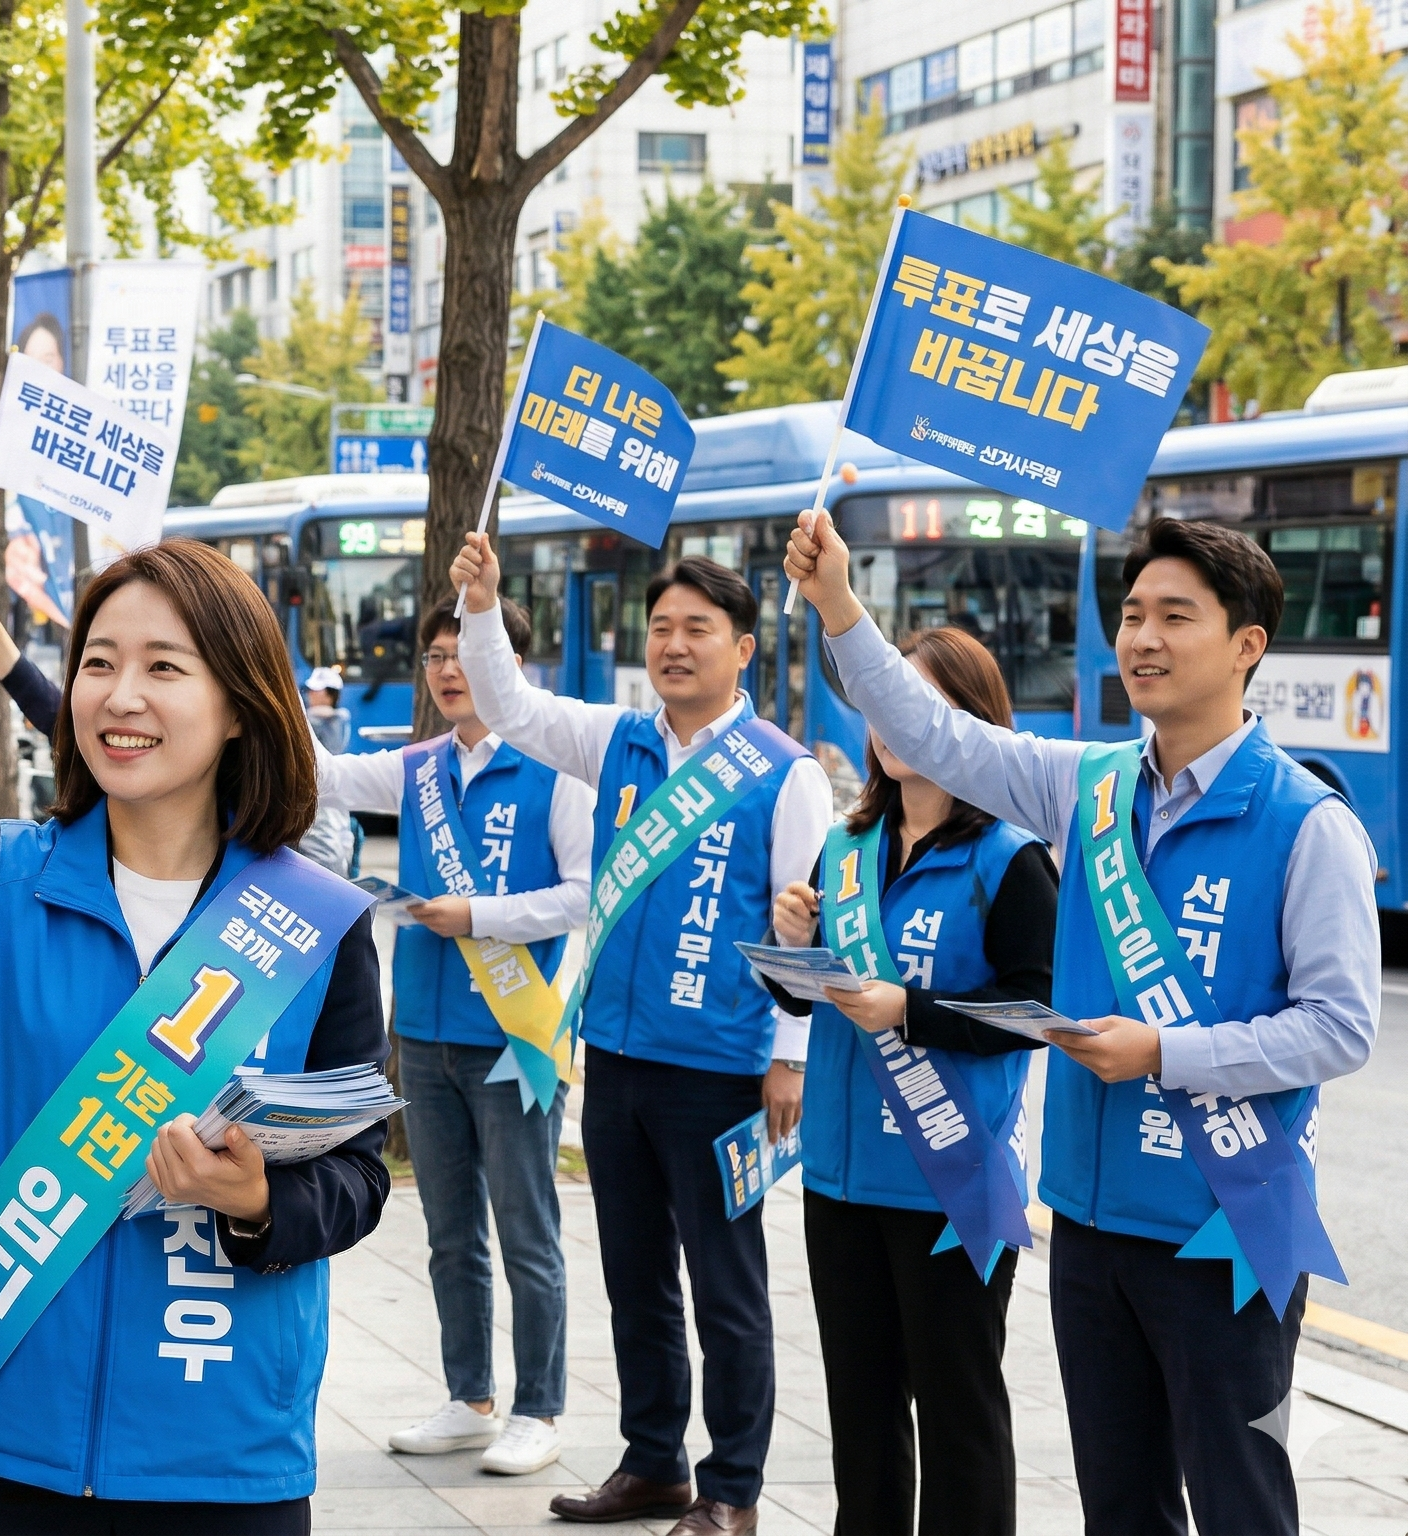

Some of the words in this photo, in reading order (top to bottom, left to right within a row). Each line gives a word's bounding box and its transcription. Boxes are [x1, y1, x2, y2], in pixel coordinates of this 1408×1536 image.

[104, 327, 178, 354] 투표로
[892, 254, 1031, 343] 투표로
[1032, 305, 1179, 398] 세상을
[103, 362, 178, 391] 세상을
[563, 365, 602, 407] 더
[602, 382, 663, 438] 나은
[909, 328, 1100, 432] 바꿉니다
[17, 381, 93, 437] 투표로
[96, 419, 164, 476] 세상을
[30, 425, 137, 498] 바꿉니다
[519, 392, 617, 461] 미래를
[618, 436, 680, 493] 위해
[339, 522, 377, 556] 99
[899, 499, 942, 541] 11
[615, 783, 638, 829] 1
[1092, 770, 1120, 841] 1
[836, 848, 864, 905] 1
[218, 916, 285, 980] 함께,
[237, 883, 322, 955] 국민과
[670, 820, 736, 1010] 선거사무원
[147, 963, 243, 1071] 1
[96, 1049, 177, 1127] 기호
[59, 1096, 143, 1182] 1번
